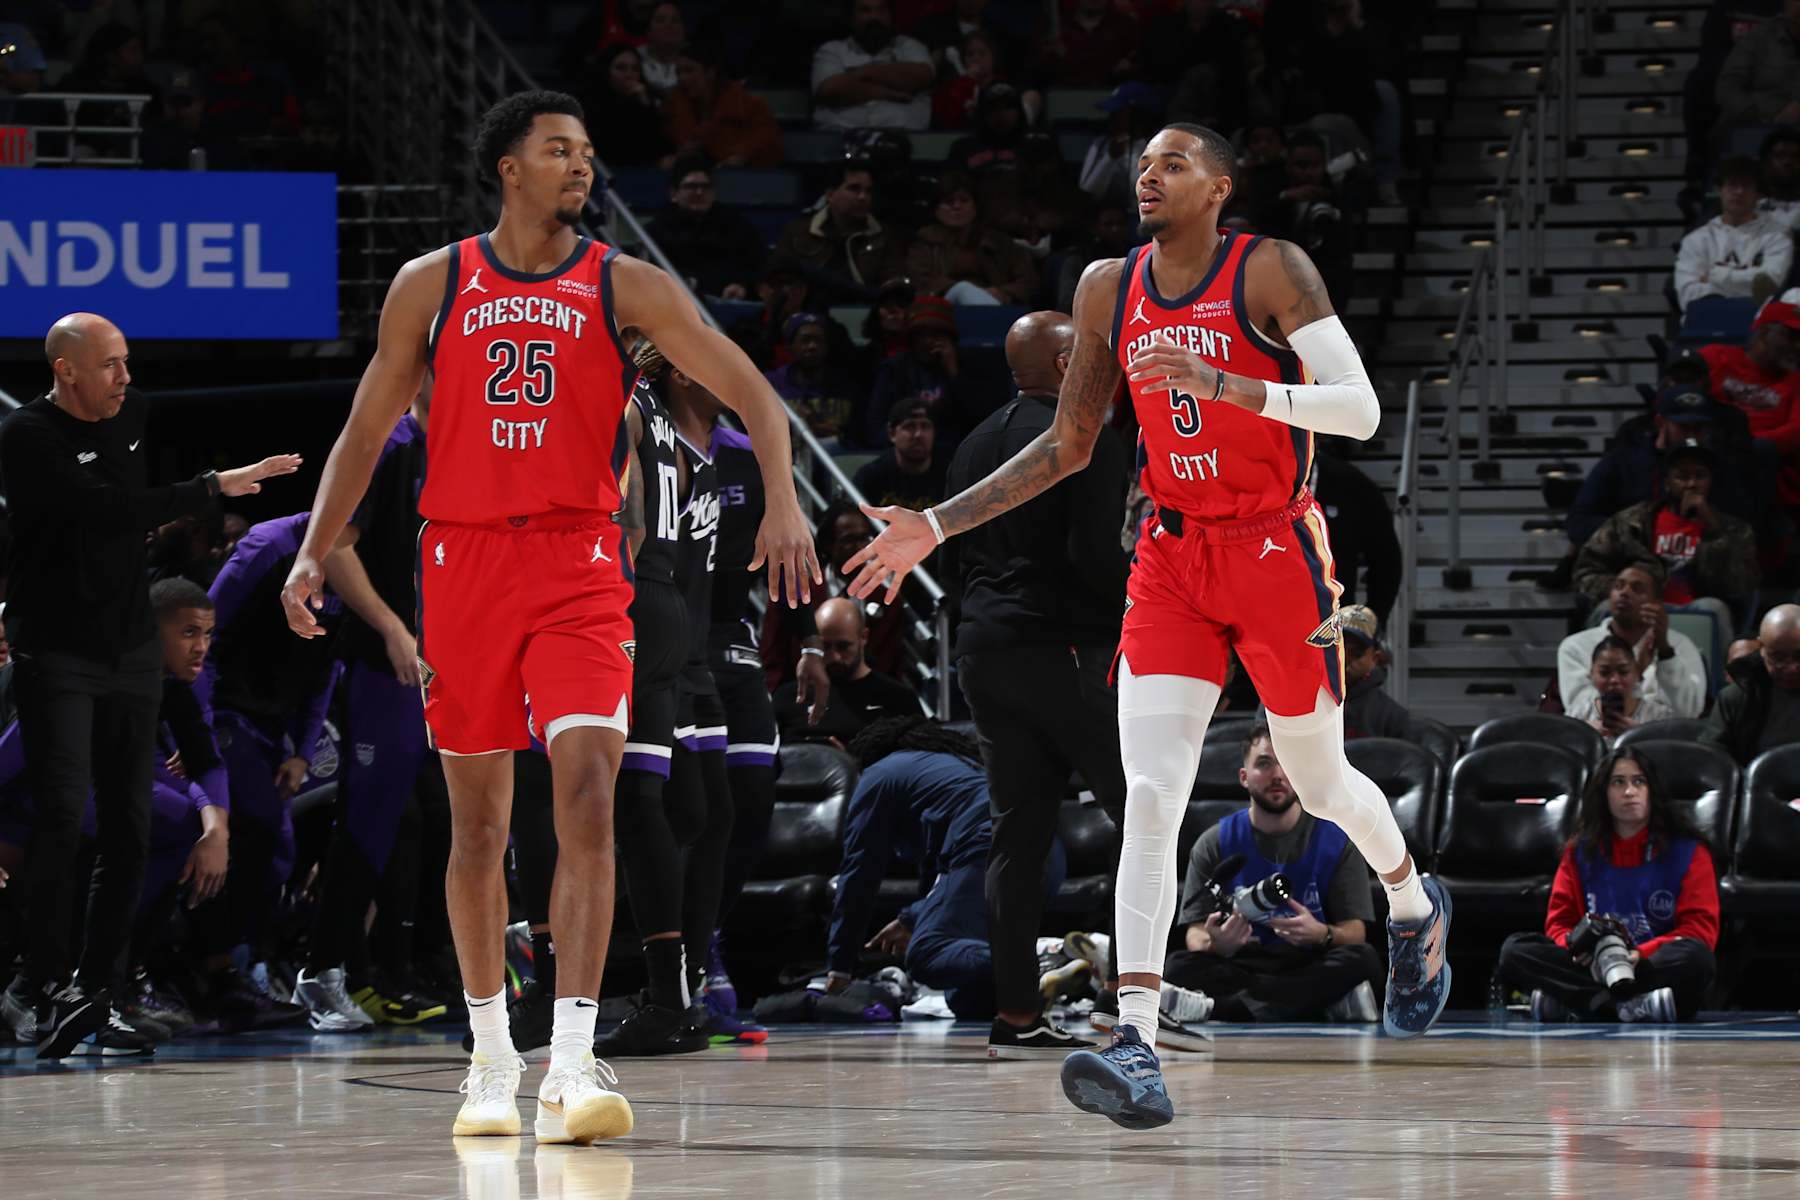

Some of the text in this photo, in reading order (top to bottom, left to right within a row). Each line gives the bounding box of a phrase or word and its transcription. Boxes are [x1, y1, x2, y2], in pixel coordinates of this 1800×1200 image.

[556, 287, 597, 299] PRODUCTS
[557, 279, 597, 293] NEWAGE
[463, 296, 588, 340] CRESCENT
[1192, 301, 1231, 313] NEWAGE
[1192, 310, 1231, 319] PRODUCTS
[485, 338, 556, 407] 25
[1168, 388, 1202, 438] 5
[491, 417, 549, 450] CITY
[1169, 448, 1219, 481] CITY
[657, 461, 679, 541] 10
